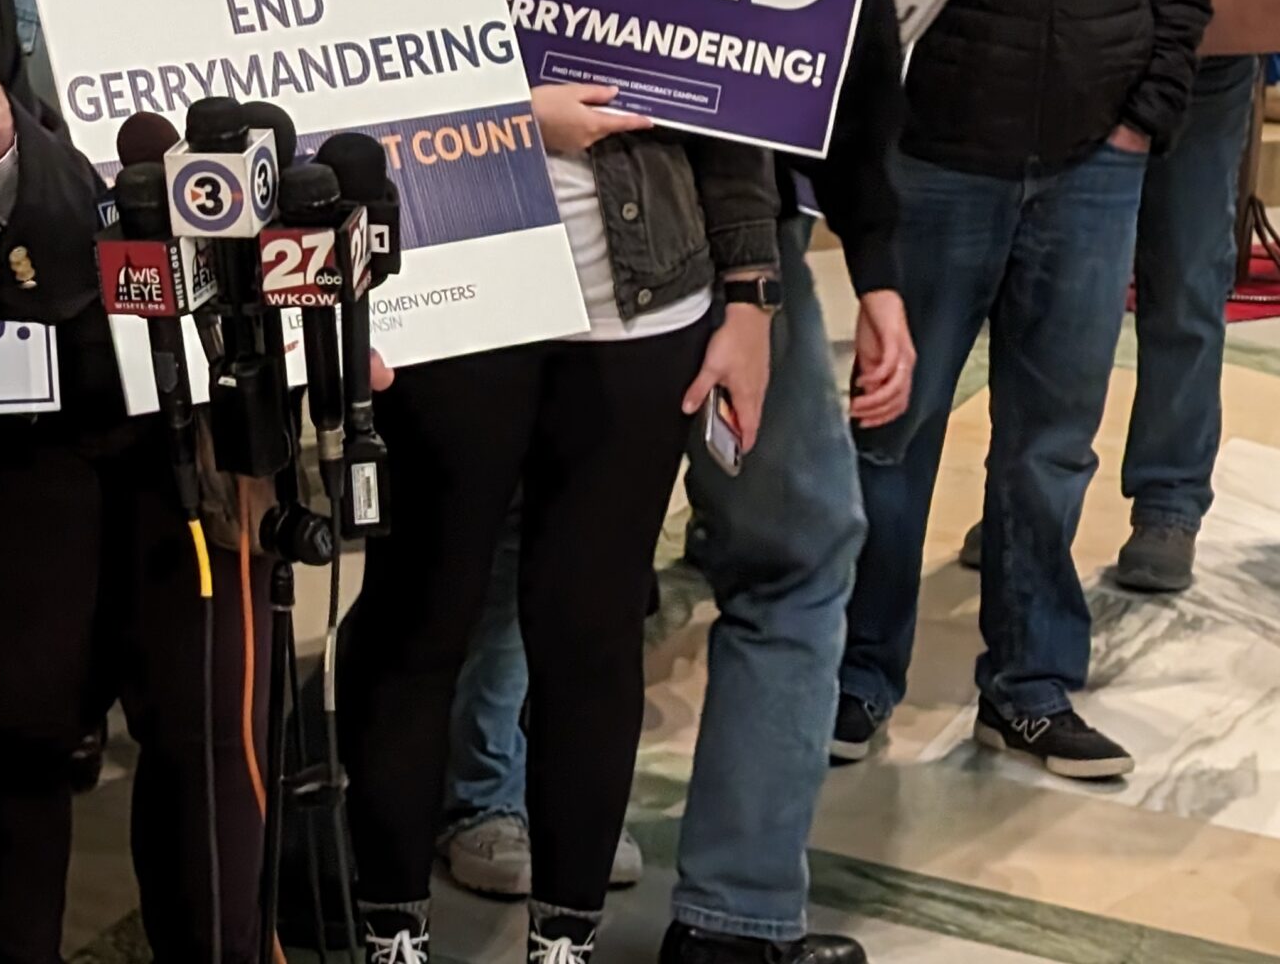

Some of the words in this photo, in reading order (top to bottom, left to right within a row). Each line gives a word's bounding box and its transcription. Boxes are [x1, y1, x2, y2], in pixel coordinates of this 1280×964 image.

[67, 20, 515, 122] GERRYMANDERING
[412, 114, 533, 165] COUNT
[194, 176, 224, 216] 3
[262, 230, 335, 293] 27
[128, 267, 160, 284] WIS
[315, 270, 343, 285] abc
[130, 283, 163, 302] EYE
[267, 293, 336, 307] WKOW
[420, 285, 476, 306] VOTERS
